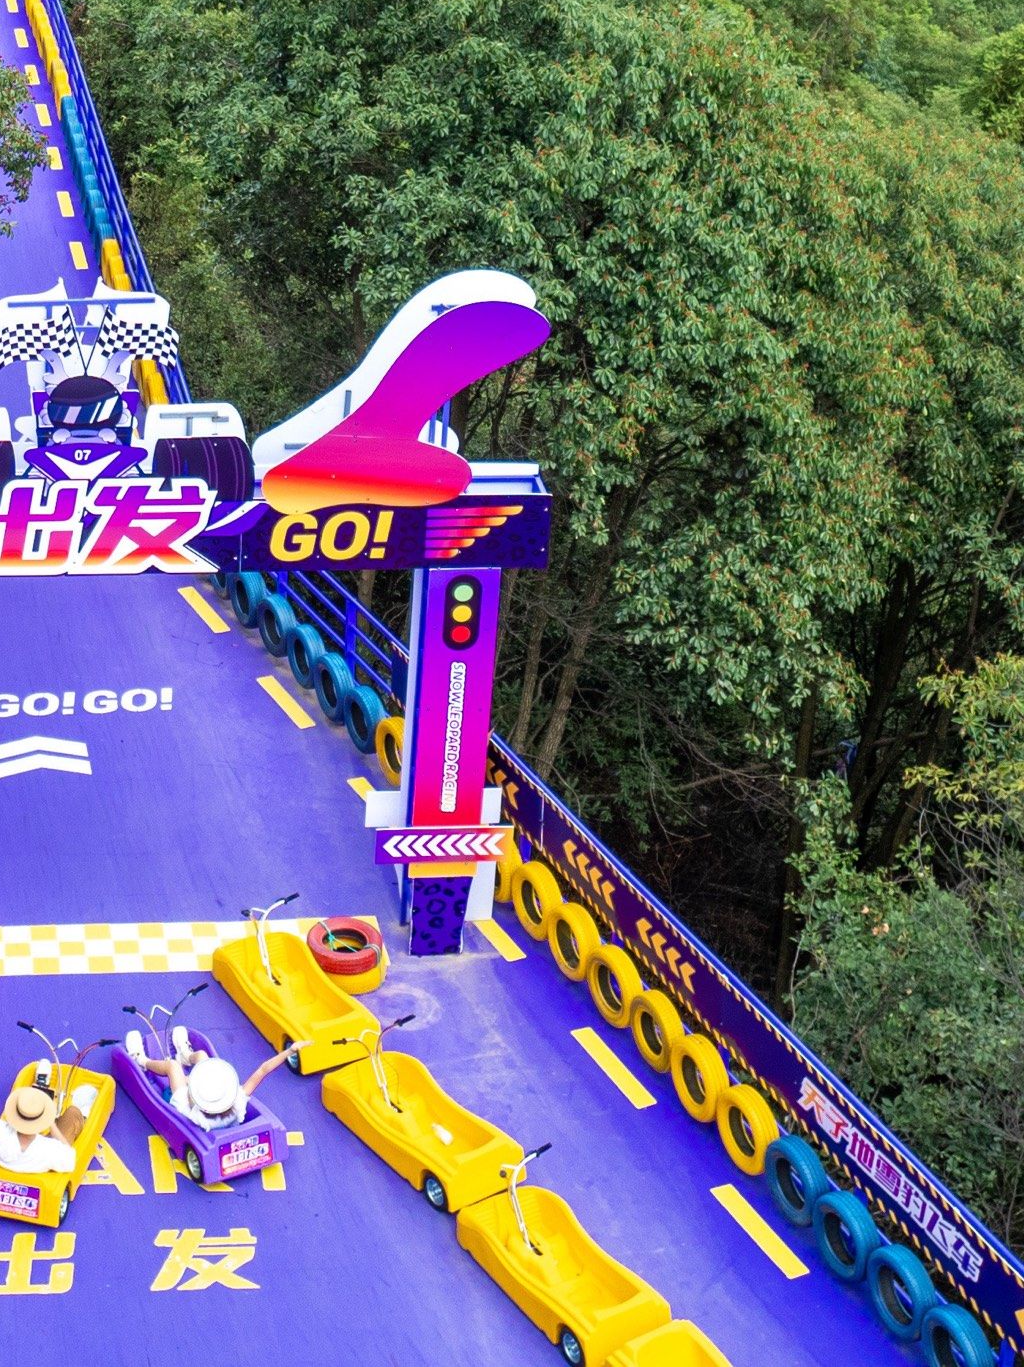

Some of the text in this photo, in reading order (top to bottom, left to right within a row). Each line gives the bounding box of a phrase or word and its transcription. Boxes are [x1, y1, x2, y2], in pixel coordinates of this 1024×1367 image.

[74, 449, 91, 461] 07
[270, 511, 394, 562] GO!
[798, 1078, 982, 1281] 天子地雪豹飞车
